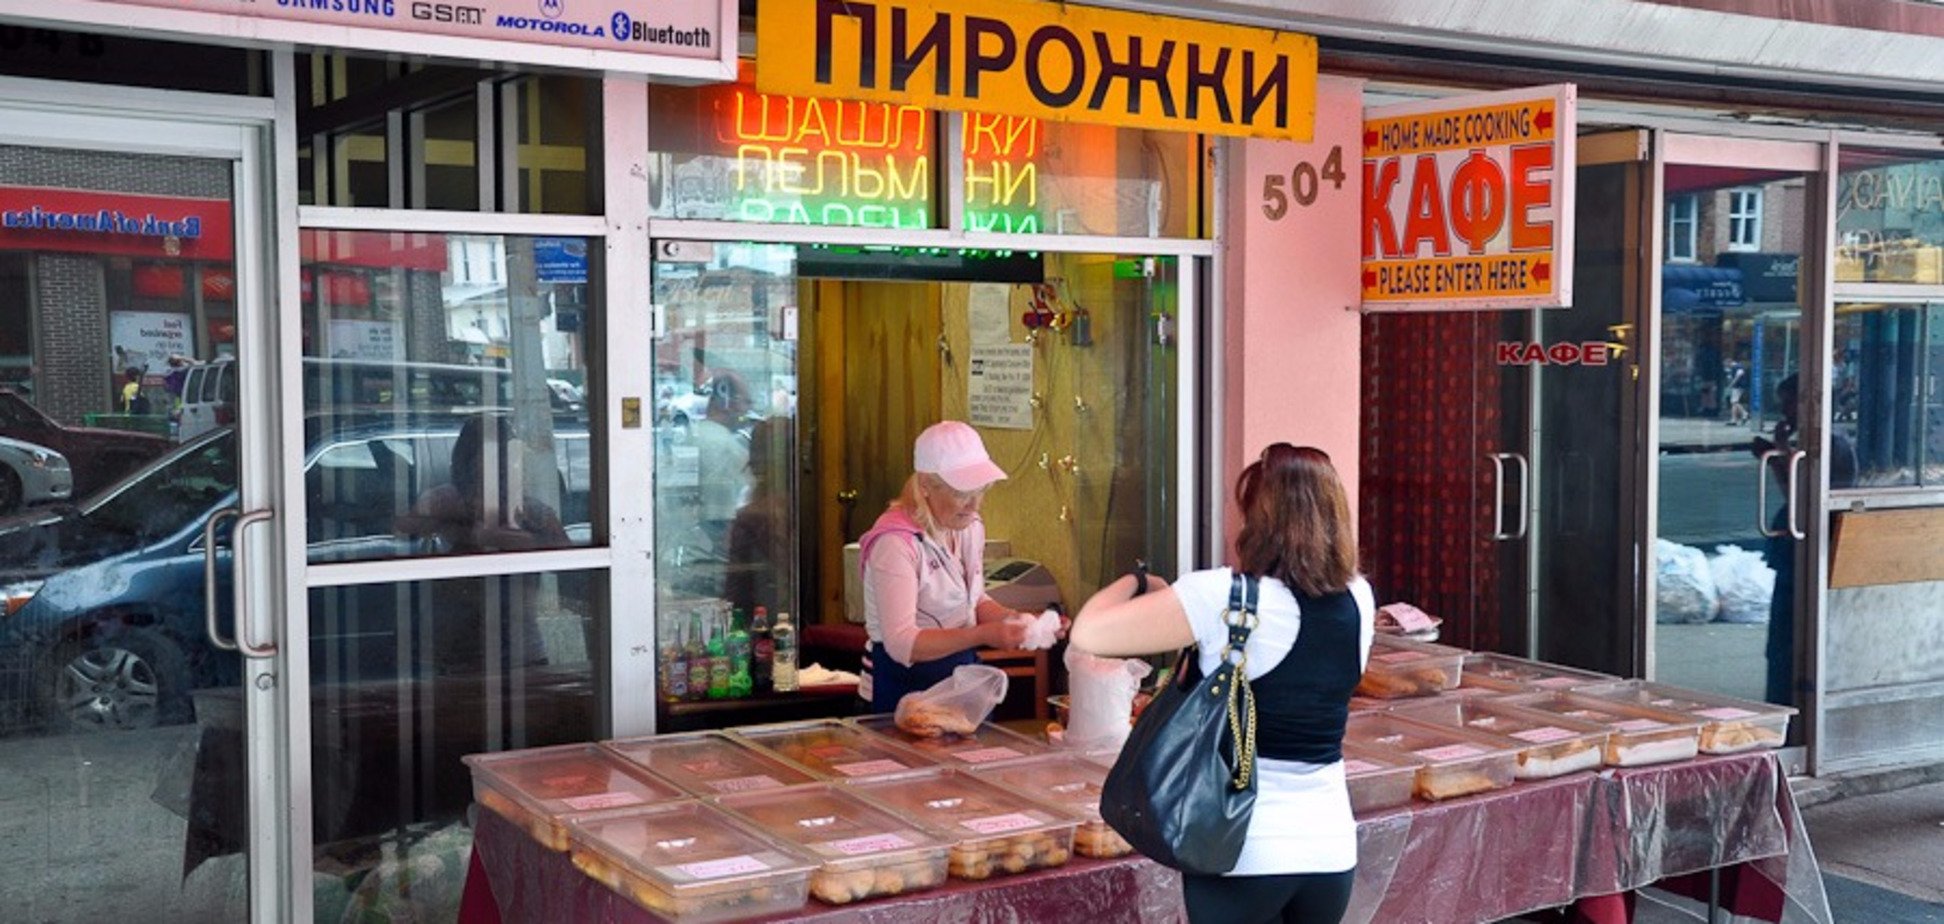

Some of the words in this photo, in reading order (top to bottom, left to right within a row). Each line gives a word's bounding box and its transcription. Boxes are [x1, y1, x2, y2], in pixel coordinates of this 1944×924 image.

[496, 16, 605, 37] MOTOROLA
[632, 21, 711, 48] Bluetooth
[814, 0, 1291, 129] ПИРОЖКИ
[736, 92, 1036, 158] ШАШЛКИ
[1382, 122, 1420, 151] HOME
[1422, 115, 1462, 147] MADE
[1464, 107, 1532, 143] COOKING
[737, 144, 1037, 207] ПЕЛЬМНИ
[1262, 145, 1346, 221] 504
[1361, 140, 1554, 260] КАФЕ
[1379, 265, 1431, 295] PLEASE
[1434, 262, 1483, 292] ENTER
[1487, 260, 1528, 290] HERE
[1498, 343, 1607, 365] КАФЕ
